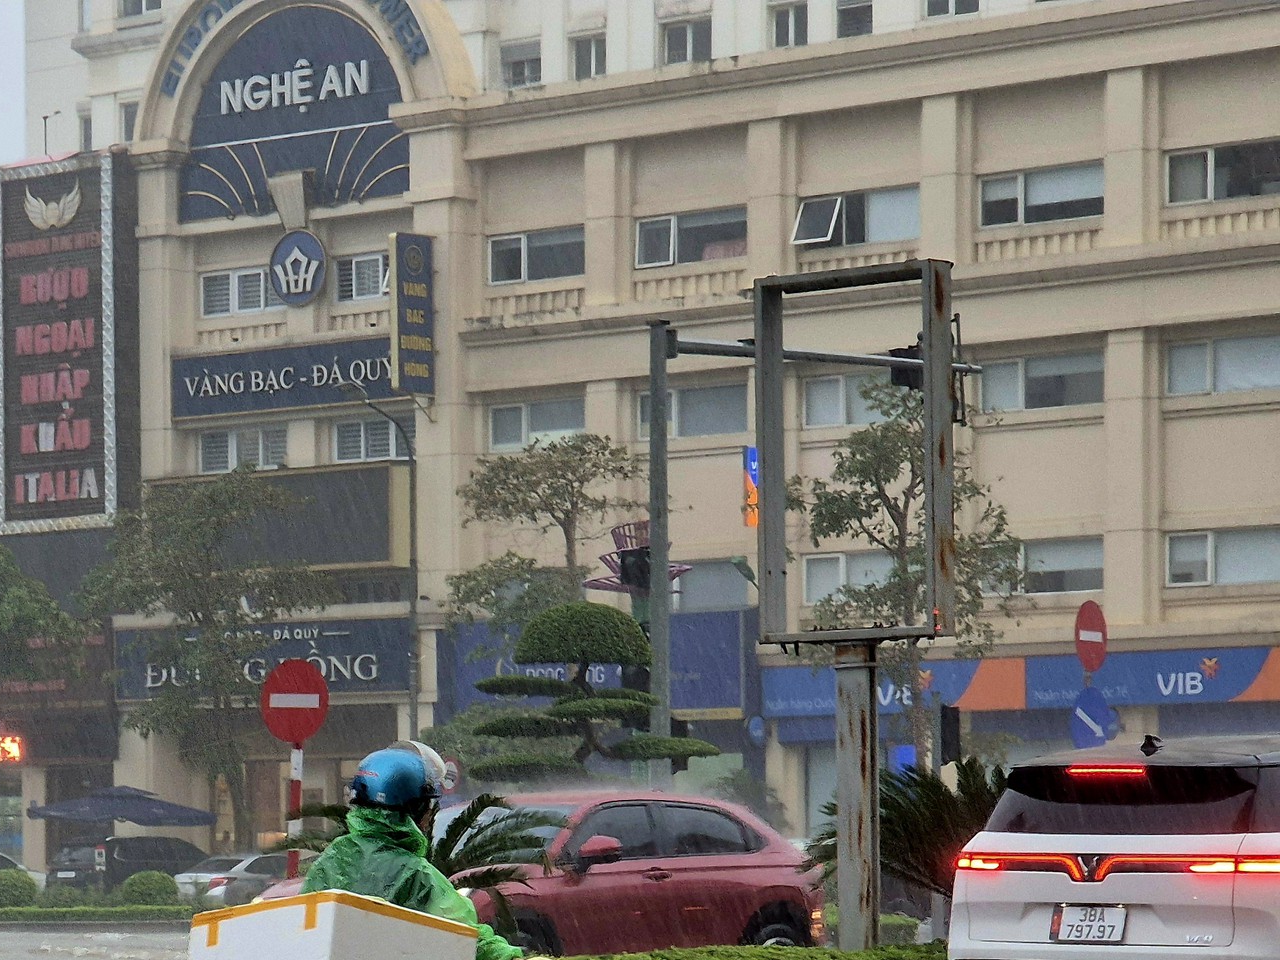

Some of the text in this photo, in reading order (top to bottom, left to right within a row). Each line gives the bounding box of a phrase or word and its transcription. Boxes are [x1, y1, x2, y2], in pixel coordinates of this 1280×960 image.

[220, 58, 370, 114] NGHỆ AN
[15, 317, 95, 358] NGOẠI
[184, 368, 245, 398] VÀNG
[249, 366, 295, 395] BẠC
[311, 356, 344, 387] ĐÁ
[15, 467, 99, 504] ITALIA
[1157, 671, 1204, 697] VIB
[1066, 924, 1116, 940] 797.97
[1079, 907, 1106, 923] 38A
